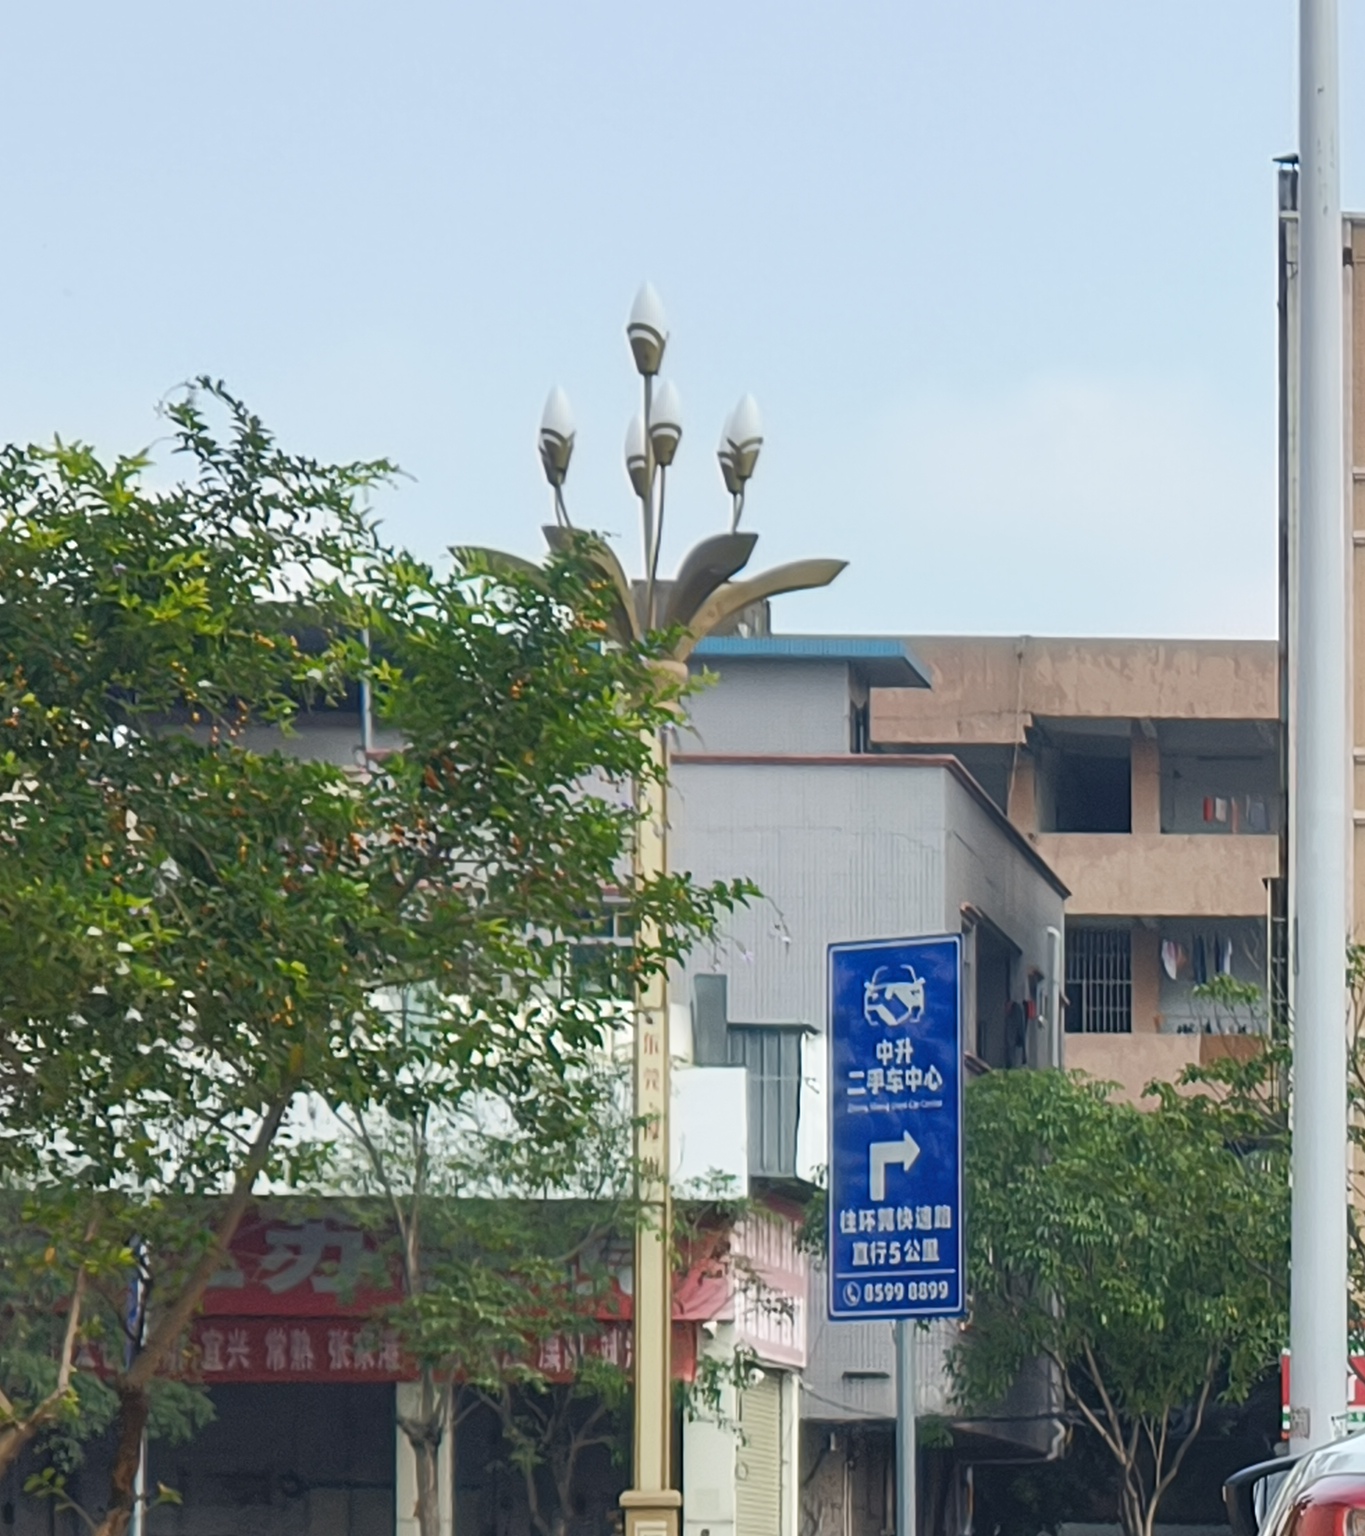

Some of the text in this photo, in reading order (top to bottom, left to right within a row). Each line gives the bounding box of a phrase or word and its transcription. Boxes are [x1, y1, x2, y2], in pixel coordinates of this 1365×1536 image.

[876, 1037, 914, 1066] 中升
[847, 1064, 943, 1095] 二手车中心
[852, 1237, 940, 1266] 直行5公里
